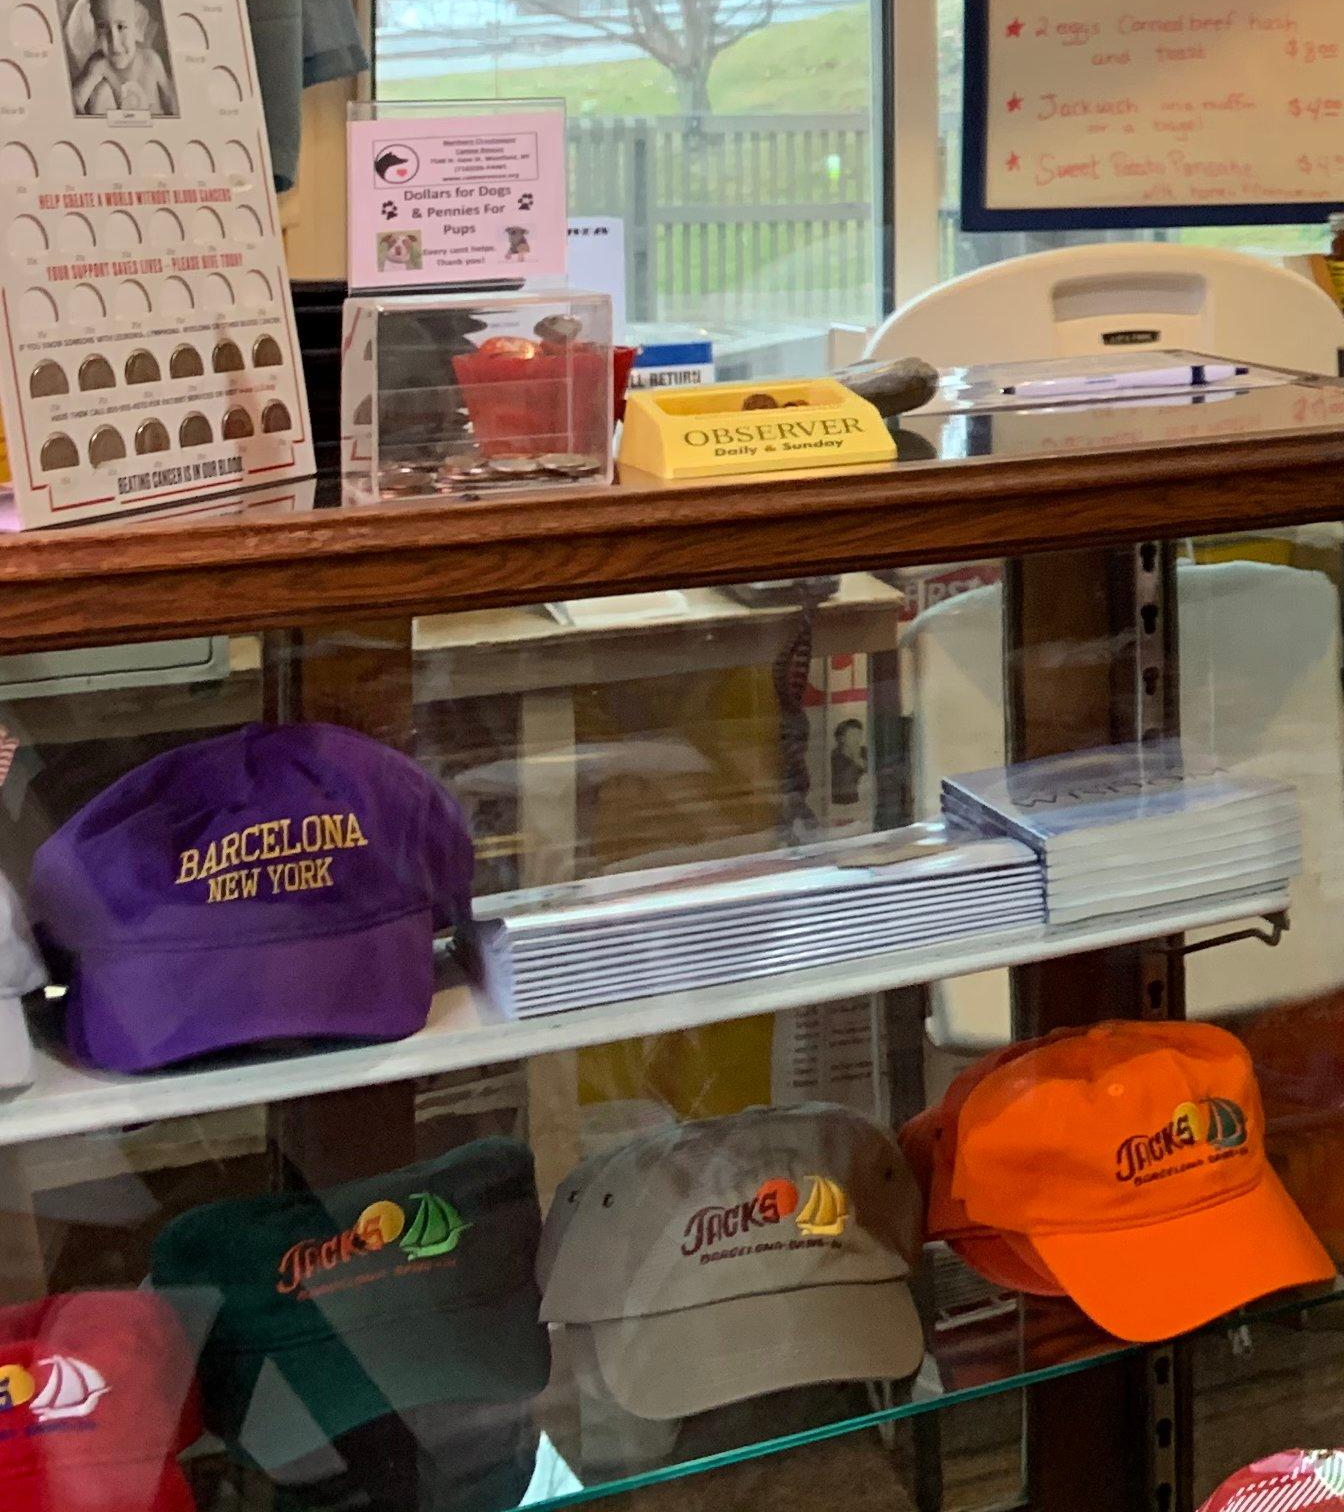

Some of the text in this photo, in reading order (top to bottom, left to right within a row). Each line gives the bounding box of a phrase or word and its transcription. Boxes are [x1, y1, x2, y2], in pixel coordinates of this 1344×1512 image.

[38, 194, 61, 210] HELP
[63, 192, 96, 209] CREATE
[104, 190, 134, 208] WORLD
[136, 189, 171, 206] WITHOUT
[173, 189, 198, 204] BLOOD
[404, 185, 512, 202] Dollars for Dogs
[411, 202, 506, 220] & Pennies For
[443, 223, 476, 237] Pups
[71, 261, 109, 281] SUPPORT
[171, 255, 200, 273] PLEASE
[683, 416, 866, 448] OBSERVER
[713, 438, 844, 458] Daily & Sunday
[117, 471, 152, 495] BEATING
[152, 465, 184, 489] CANCER
[174, 811, 370, 886] BARCELONA
[206, 854, 334, 905] NEW YORK
